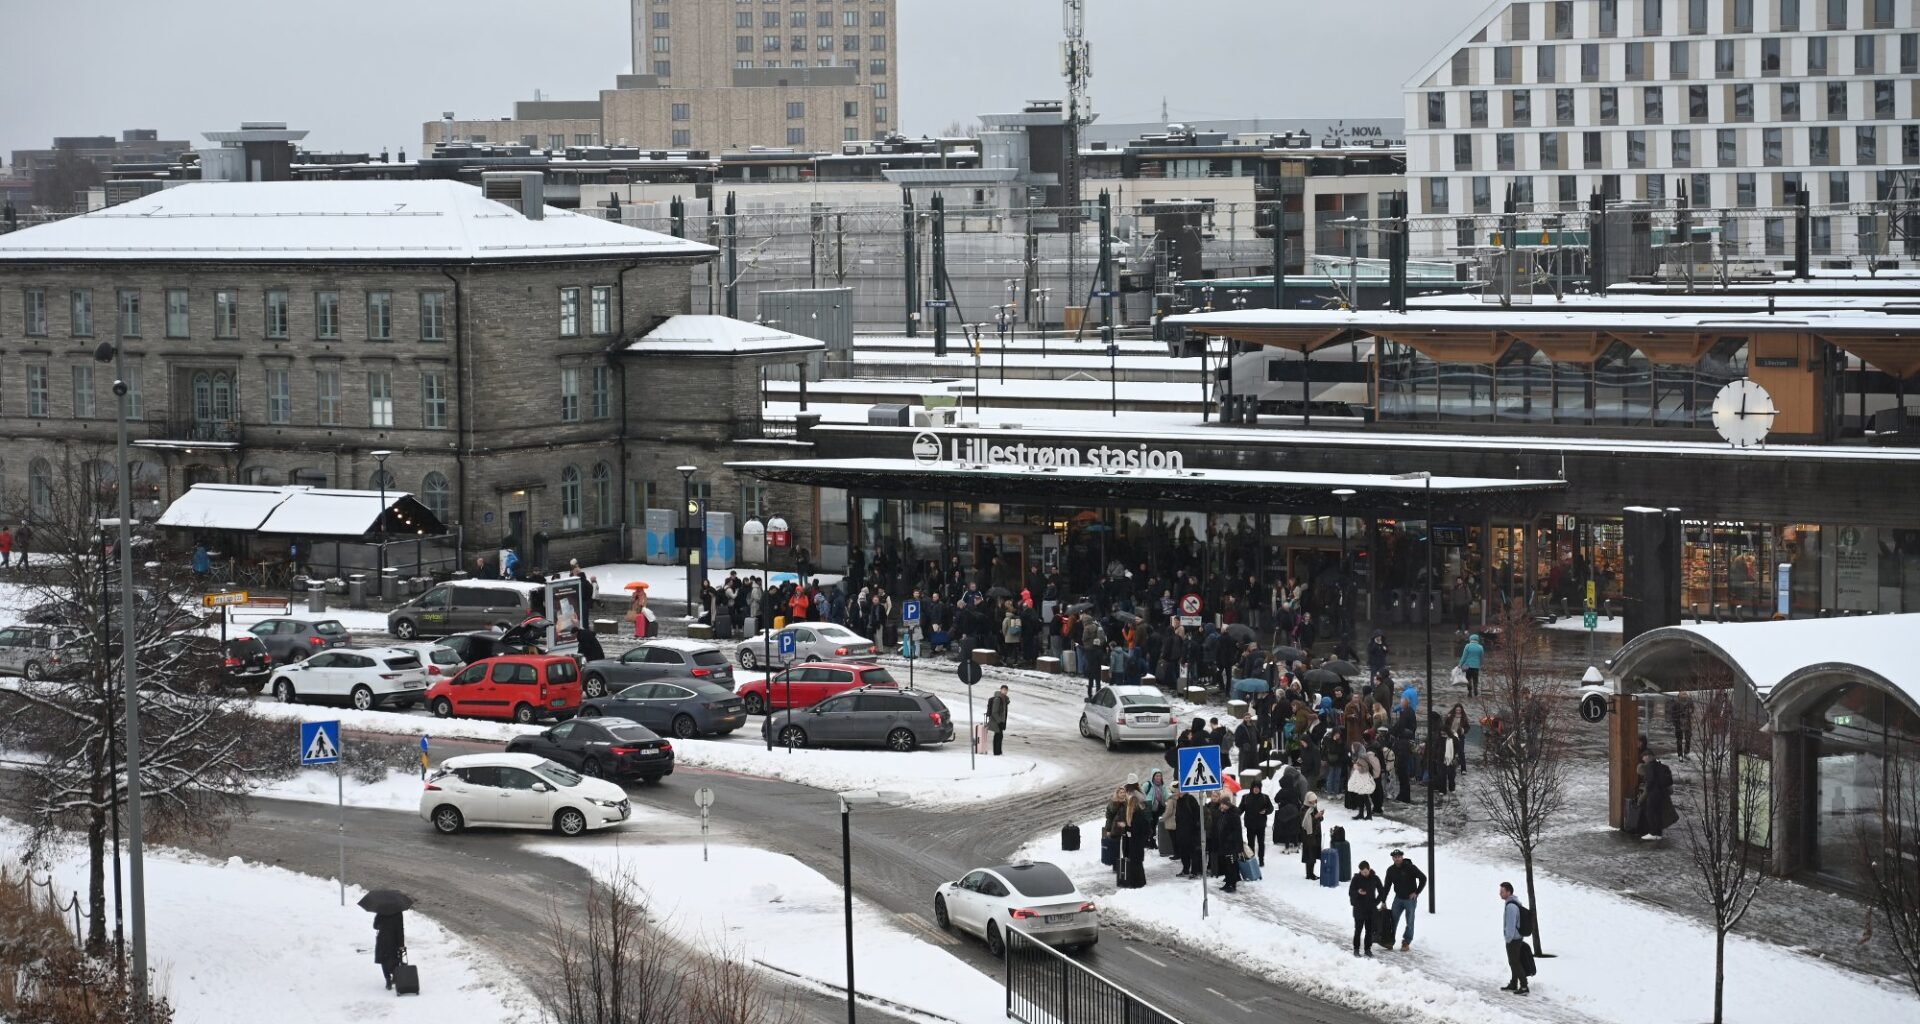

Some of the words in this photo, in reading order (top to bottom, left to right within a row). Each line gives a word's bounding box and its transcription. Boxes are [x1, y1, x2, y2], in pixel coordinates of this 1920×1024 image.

[1351, 126, 1382, 137] NOVA
[951, 437, 1080, 467] Lillestrøm
[1087, 443, 1183, 475] stasjon
[1589, 699, 1601, 719] b
